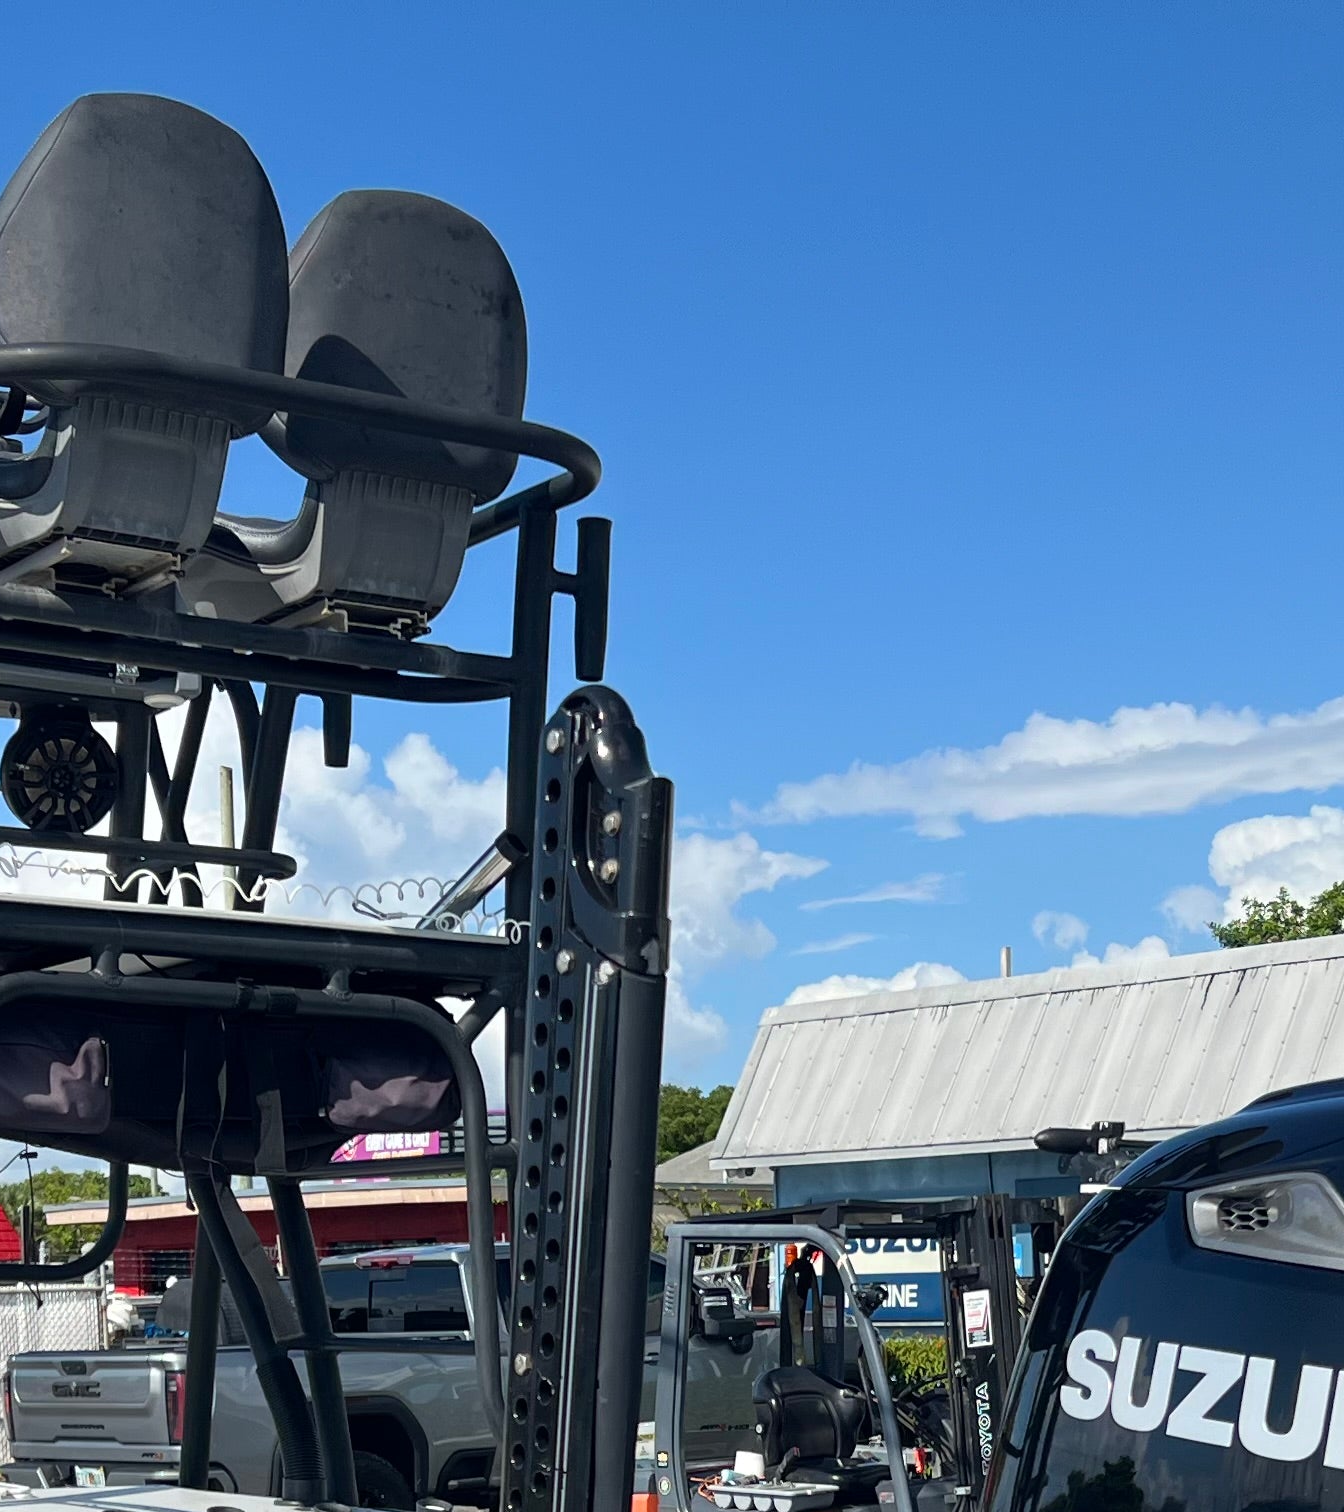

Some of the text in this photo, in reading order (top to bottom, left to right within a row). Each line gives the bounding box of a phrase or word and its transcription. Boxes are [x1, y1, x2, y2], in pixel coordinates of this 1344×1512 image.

[844, 1238, 938, 1255] SUZU
[52, 1381, 101, 1398] GMC
[976, 1381, 993, 1476] TOYOTA
